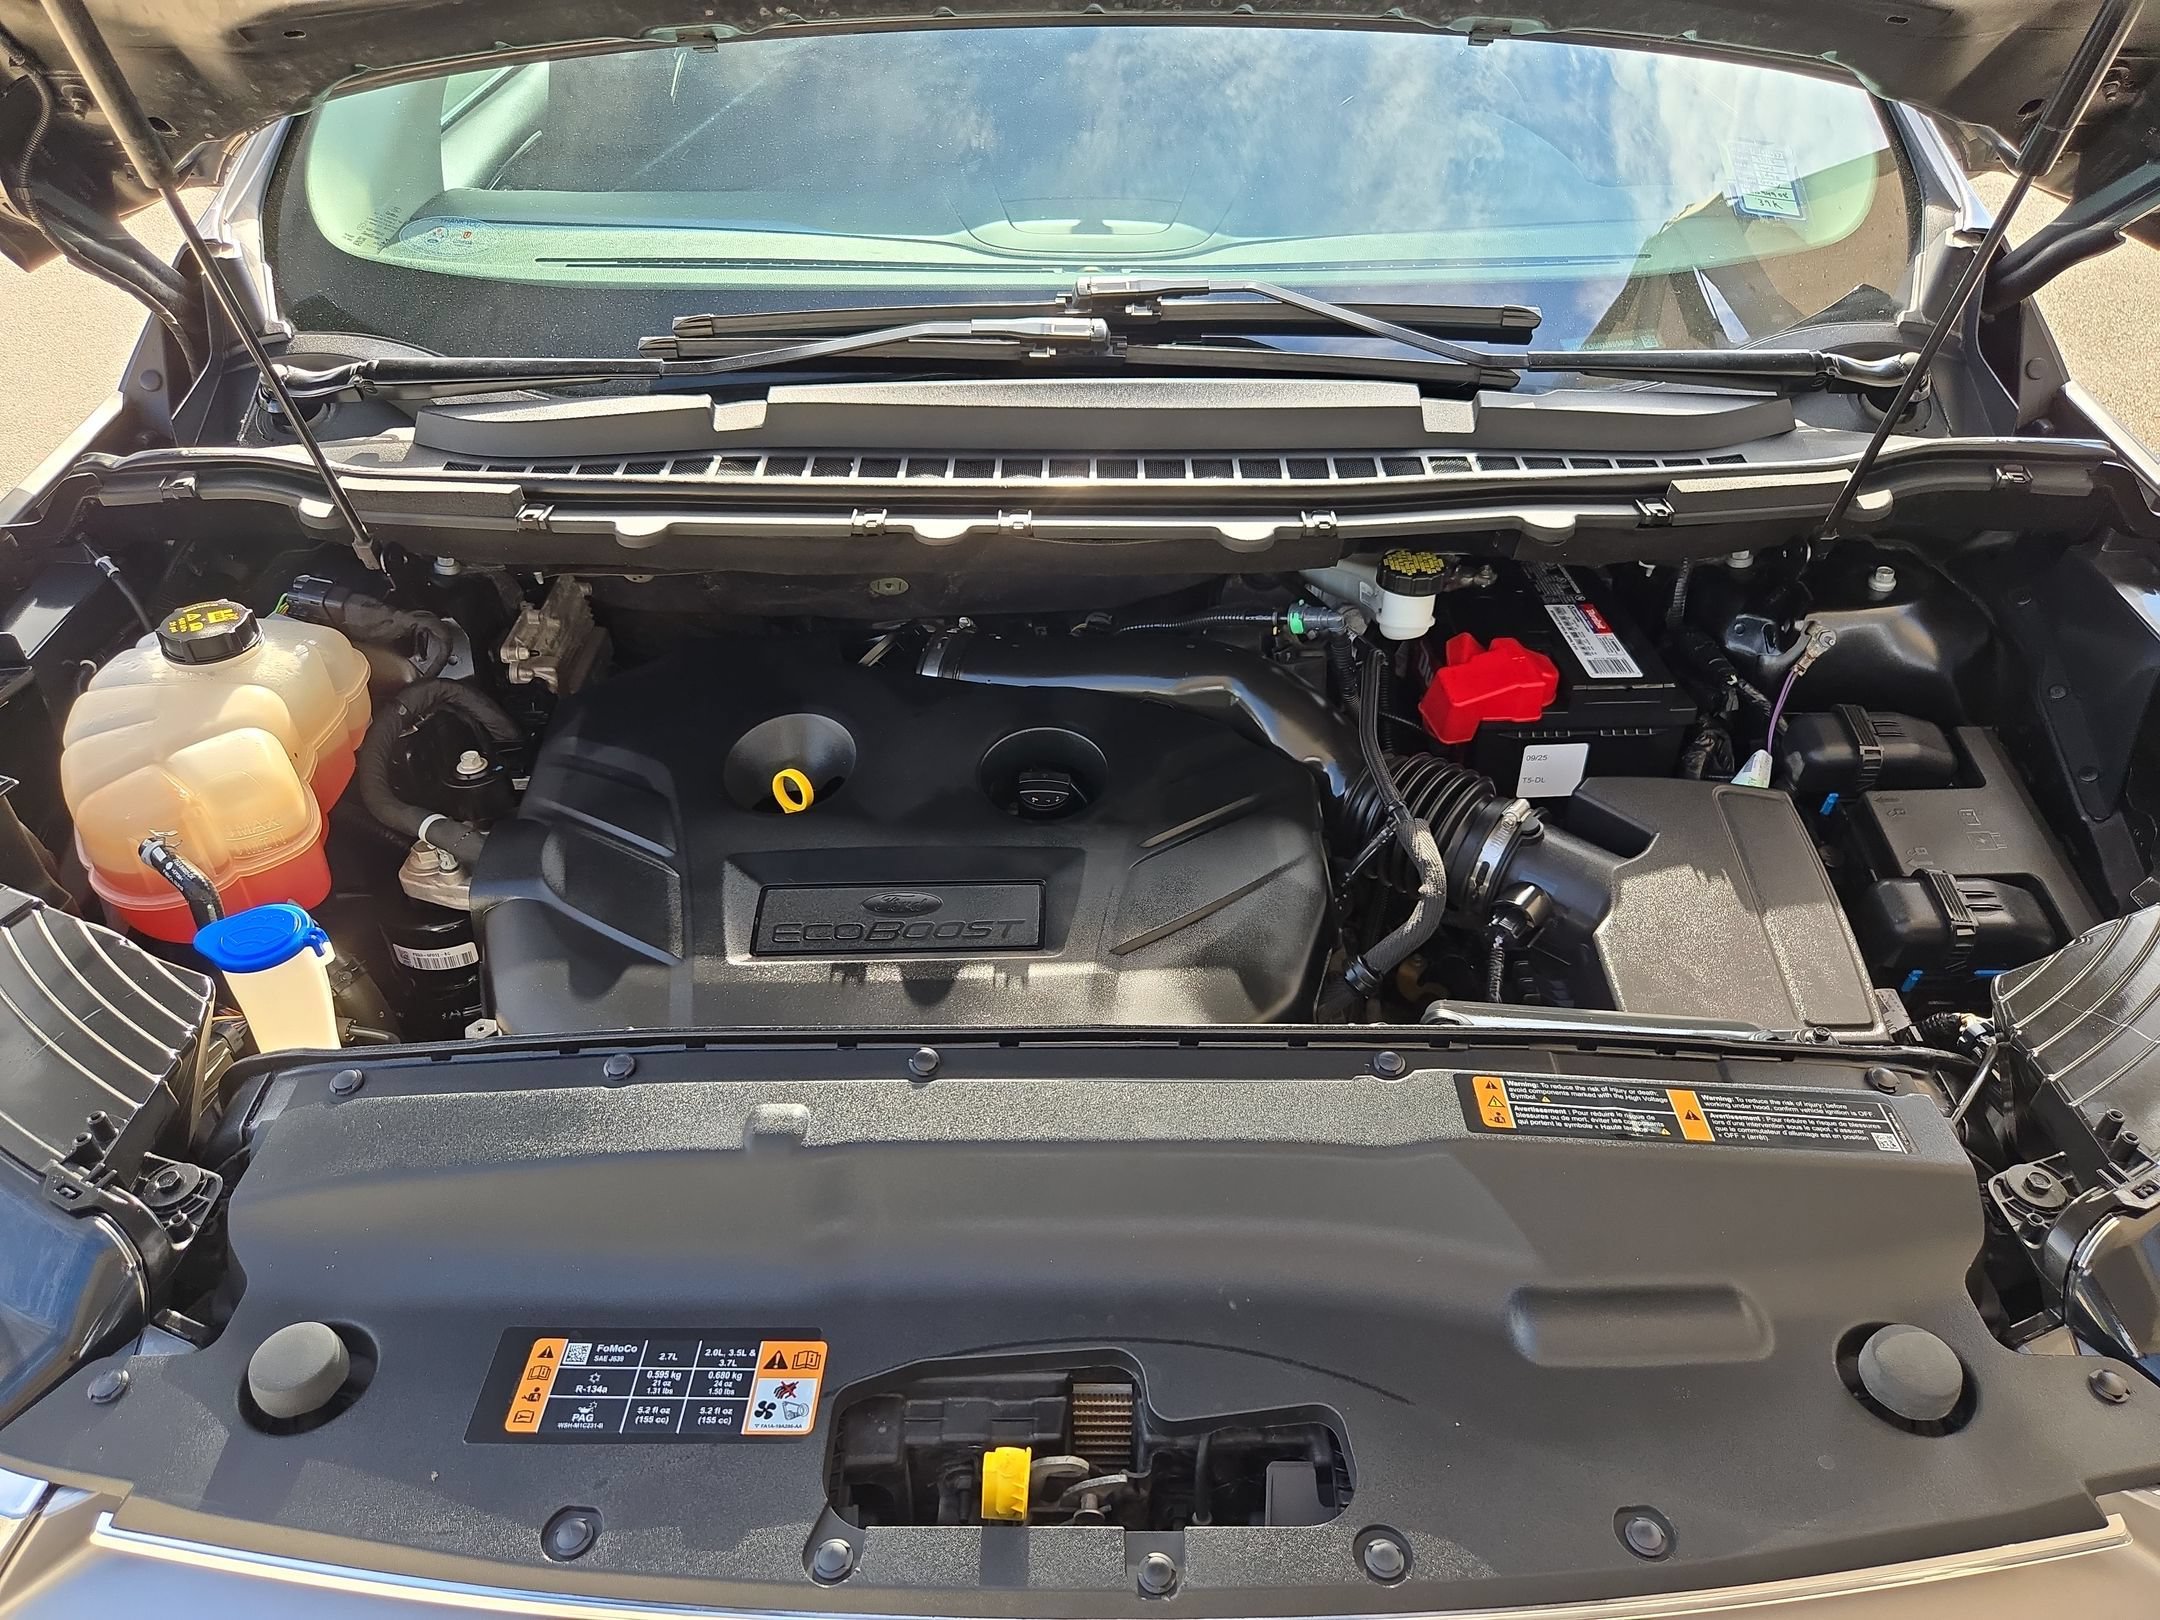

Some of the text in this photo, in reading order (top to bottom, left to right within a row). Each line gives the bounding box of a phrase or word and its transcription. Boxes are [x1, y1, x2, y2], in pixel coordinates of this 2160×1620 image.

[1506, 1080, 1540, 1088] Warning:
[1610, 1087, 1627, 1095] injury
[1701, 1095, 1734, 1103] Warning:
[1514, 1106, 1567, 1115] Avertissement
[1825, 1108, 1849, 1116] ignition
[1710, 1113, 1760, 1121] Avertissement
[596, 1345, 638, 1353] FoMoCo
[704, 1349, 726, 1357] 2.0L,
[658, 1353, 678, 1361] 2.7L
[647, 1371, 682, 1381] 0.595 kg
[732, 1372, 742, 1381] kg
[575, 1385, 608, 1393] R-134a
[572, 1414, 594, 1422] PAG
[635, 1416, 669, 1425] (155 cc)
[697, 1417, 732, 1425] (155 cc)
